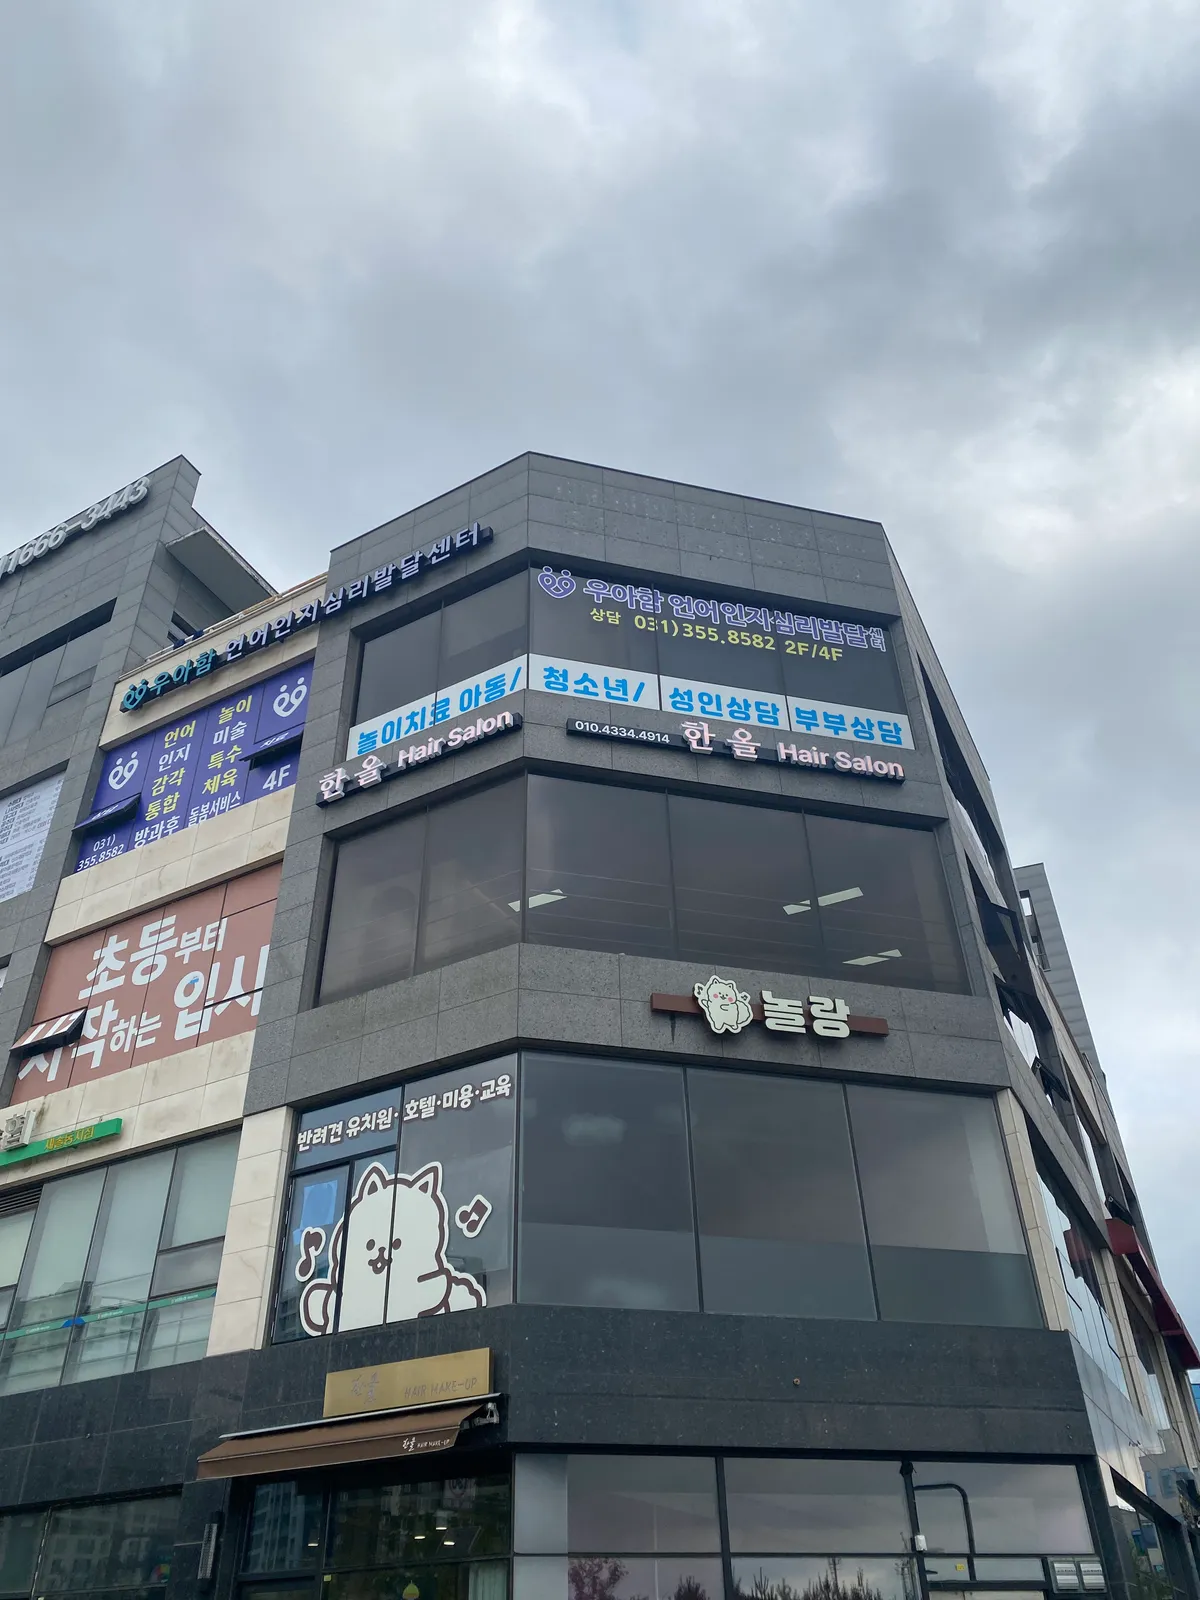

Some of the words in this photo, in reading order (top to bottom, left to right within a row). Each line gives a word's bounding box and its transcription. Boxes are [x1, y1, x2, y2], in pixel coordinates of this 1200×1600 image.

[583, 578, 664, 613] 우아함
[590, 608, 621, 625] 상담
[784, 640, 843, 661] 2F/4F
[150, 648, 216, 695] 우아함
[218, 695, 253, 725] 놀이
[668, 687, 781, 726] 성인상담
[795, 706, 904, 746] 부부상담
[164, 720, 196, 749] 언어
[212, 721, 248, 746] 미술
[356, 697, 451, 756] 놀이치료
[397, 736, 446, 769] Hair
[447, 711, 515, 746] Salon
[158, 744, 191, 772] 인지
[207, 745, 243, 770] 특수
[575, 720, 670, 744] 010.4334.4914
[776, 742, 829, 768] Hair
[833, 751, 904, 780] Salon
[152, 767, 185, 796] 감각
[202, 768, 238, 795] 체육
[262, 764, 291, 791] 4F
[145, 792, 180, 821] 통합
[188, 790, 242, 828] 돌봄서비스
[93, 834, 116, 852] 031)
[134, 815, 180, 849] 방과후
[76, 844, 125, 872] 355.8582
[174, 944, 270, 1041] 입시
[761, 990, 850, 1038] 놀랑
[297, 1120, 343, 1152] 반려견
[404, 1386, 427, 1399] HAIR
[431, 1377, 478, 1397] MAKE-UP
